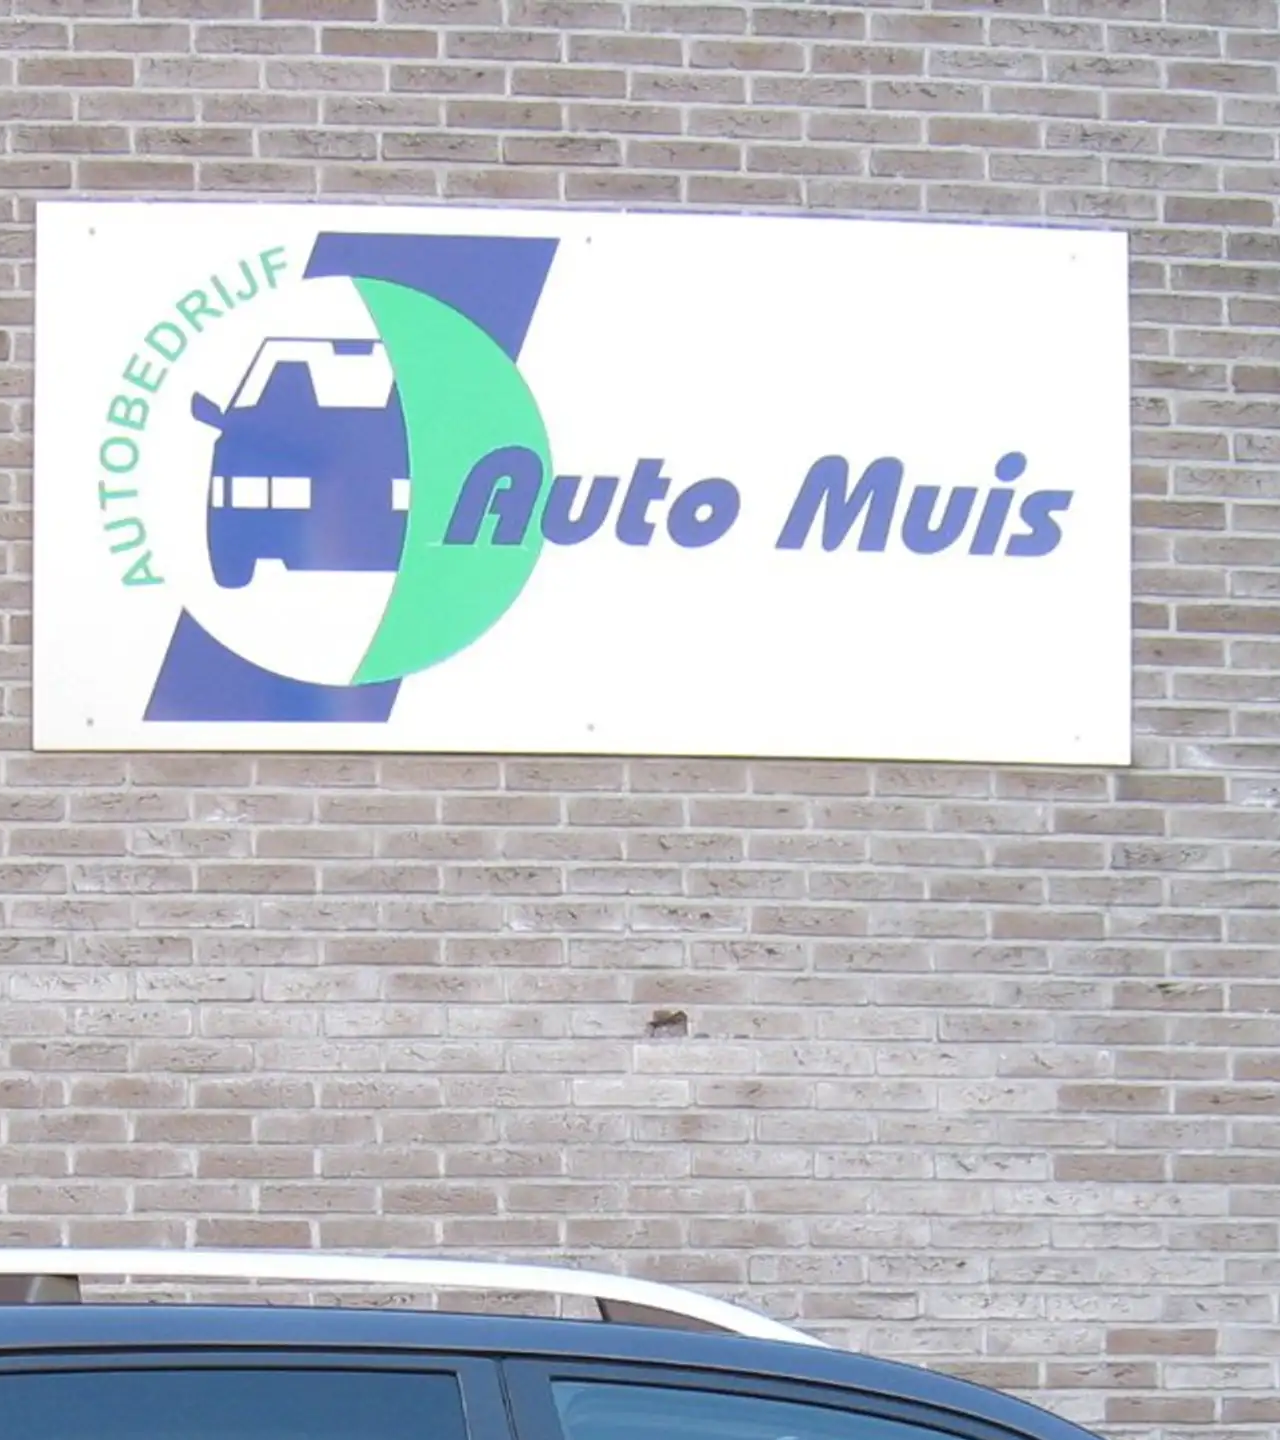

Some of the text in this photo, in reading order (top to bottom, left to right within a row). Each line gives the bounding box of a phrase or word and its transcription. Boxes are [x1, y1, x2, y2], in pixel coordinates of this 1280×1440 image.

[97, 245, 292, 590] AUTOBEDRIJF
[442, 445, 1075, 557] Auto Muis
